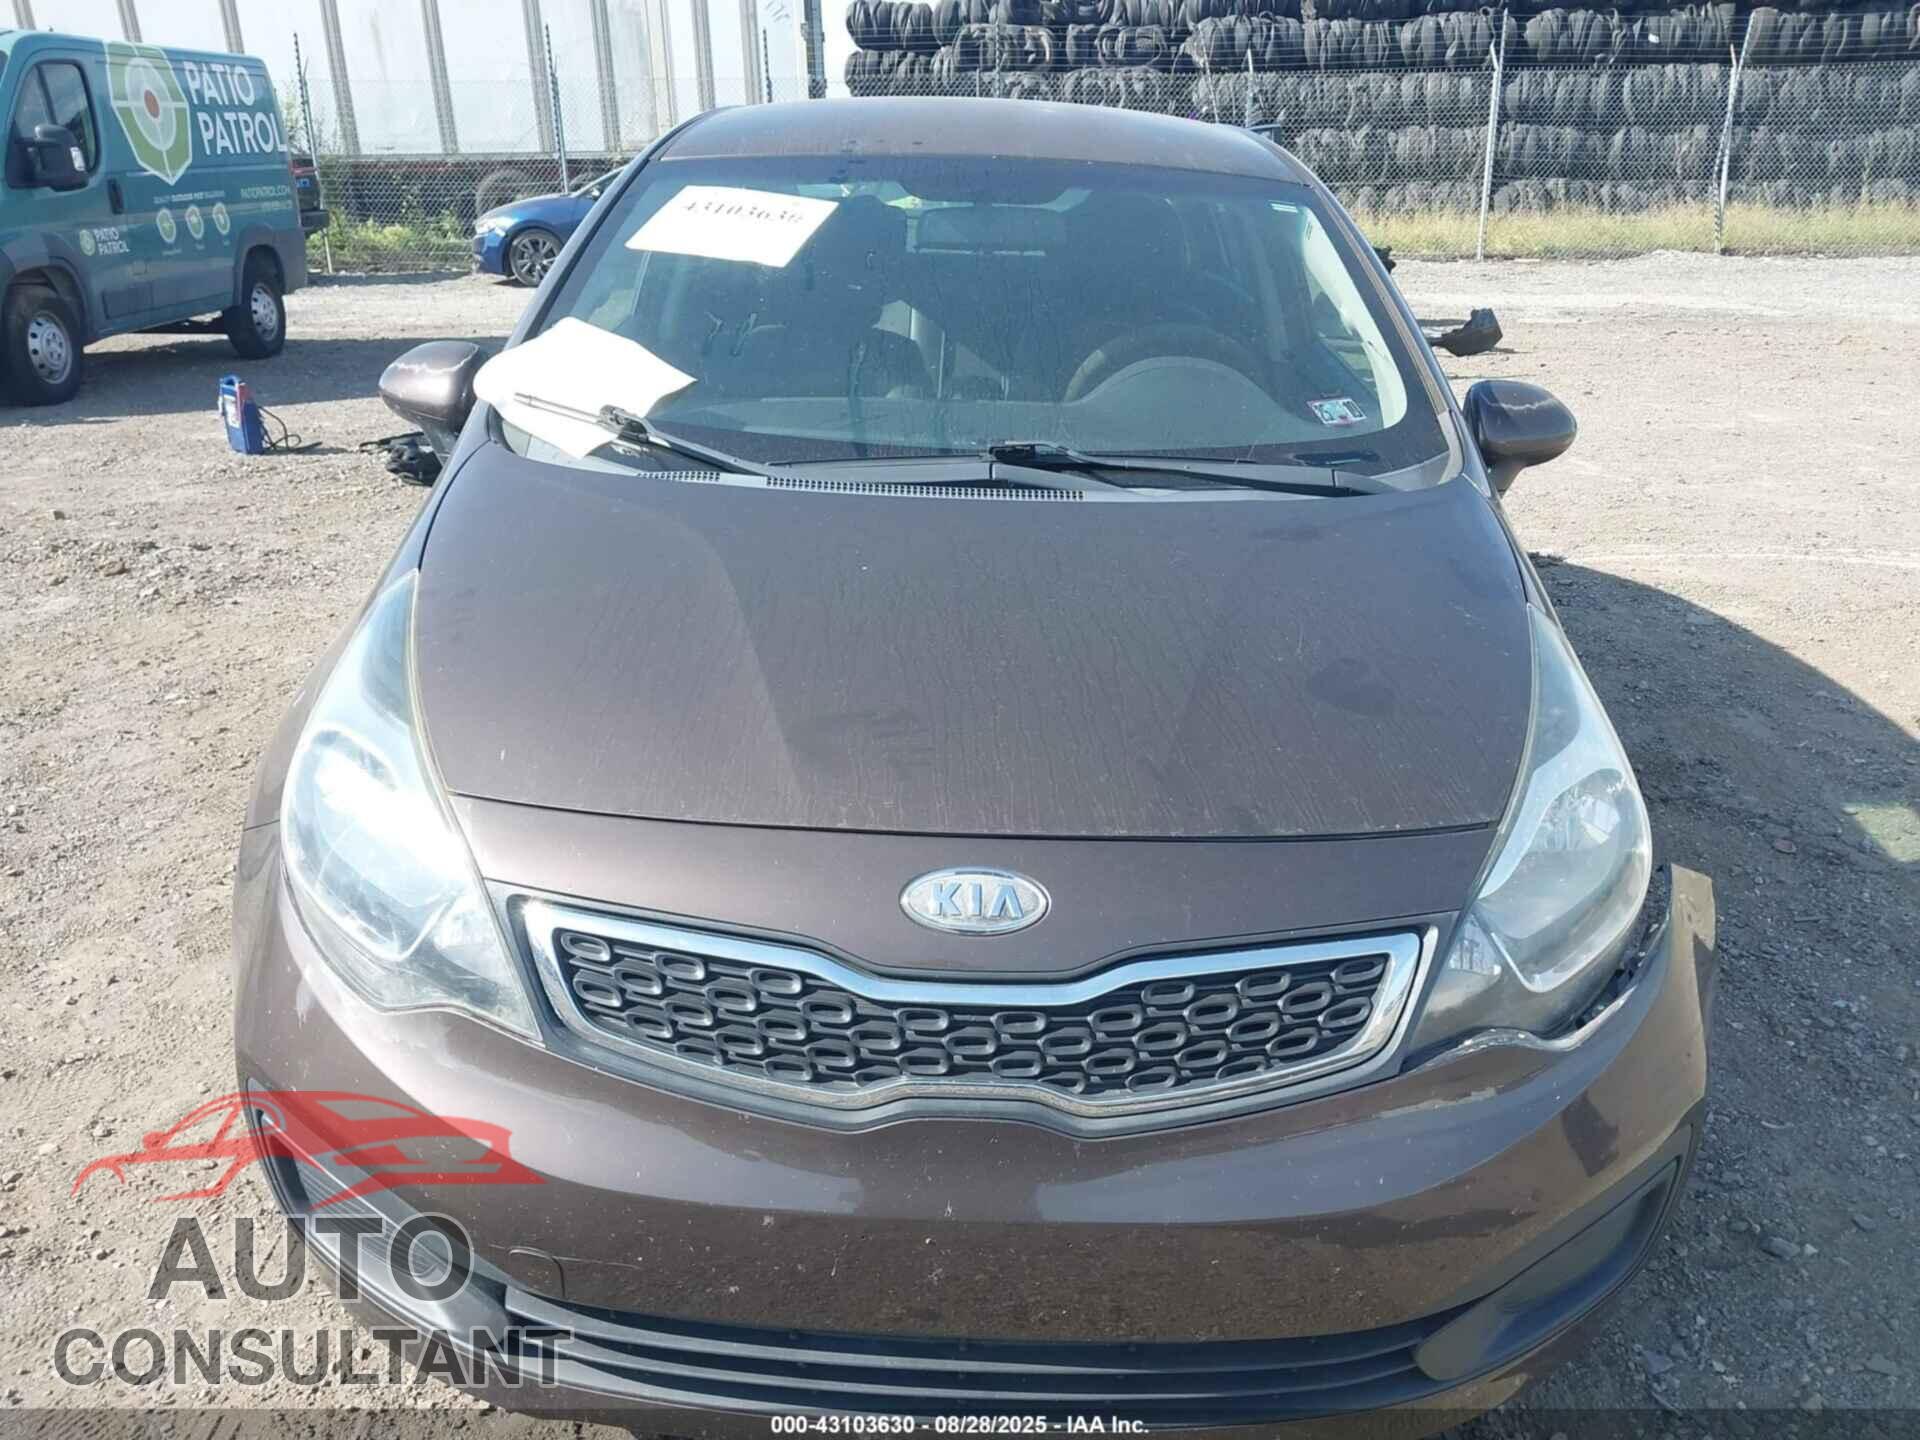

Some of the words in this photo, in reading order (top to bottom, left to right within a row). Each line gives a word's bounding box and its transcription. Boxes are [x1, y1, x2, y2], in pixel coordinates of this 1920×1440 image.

[183, 61, 255, 106] PATIO
[196, 111, 288, 155] PATROL
[93, 227, 119, 241] PATIO
[929, 880, 1024, 919] KIA
